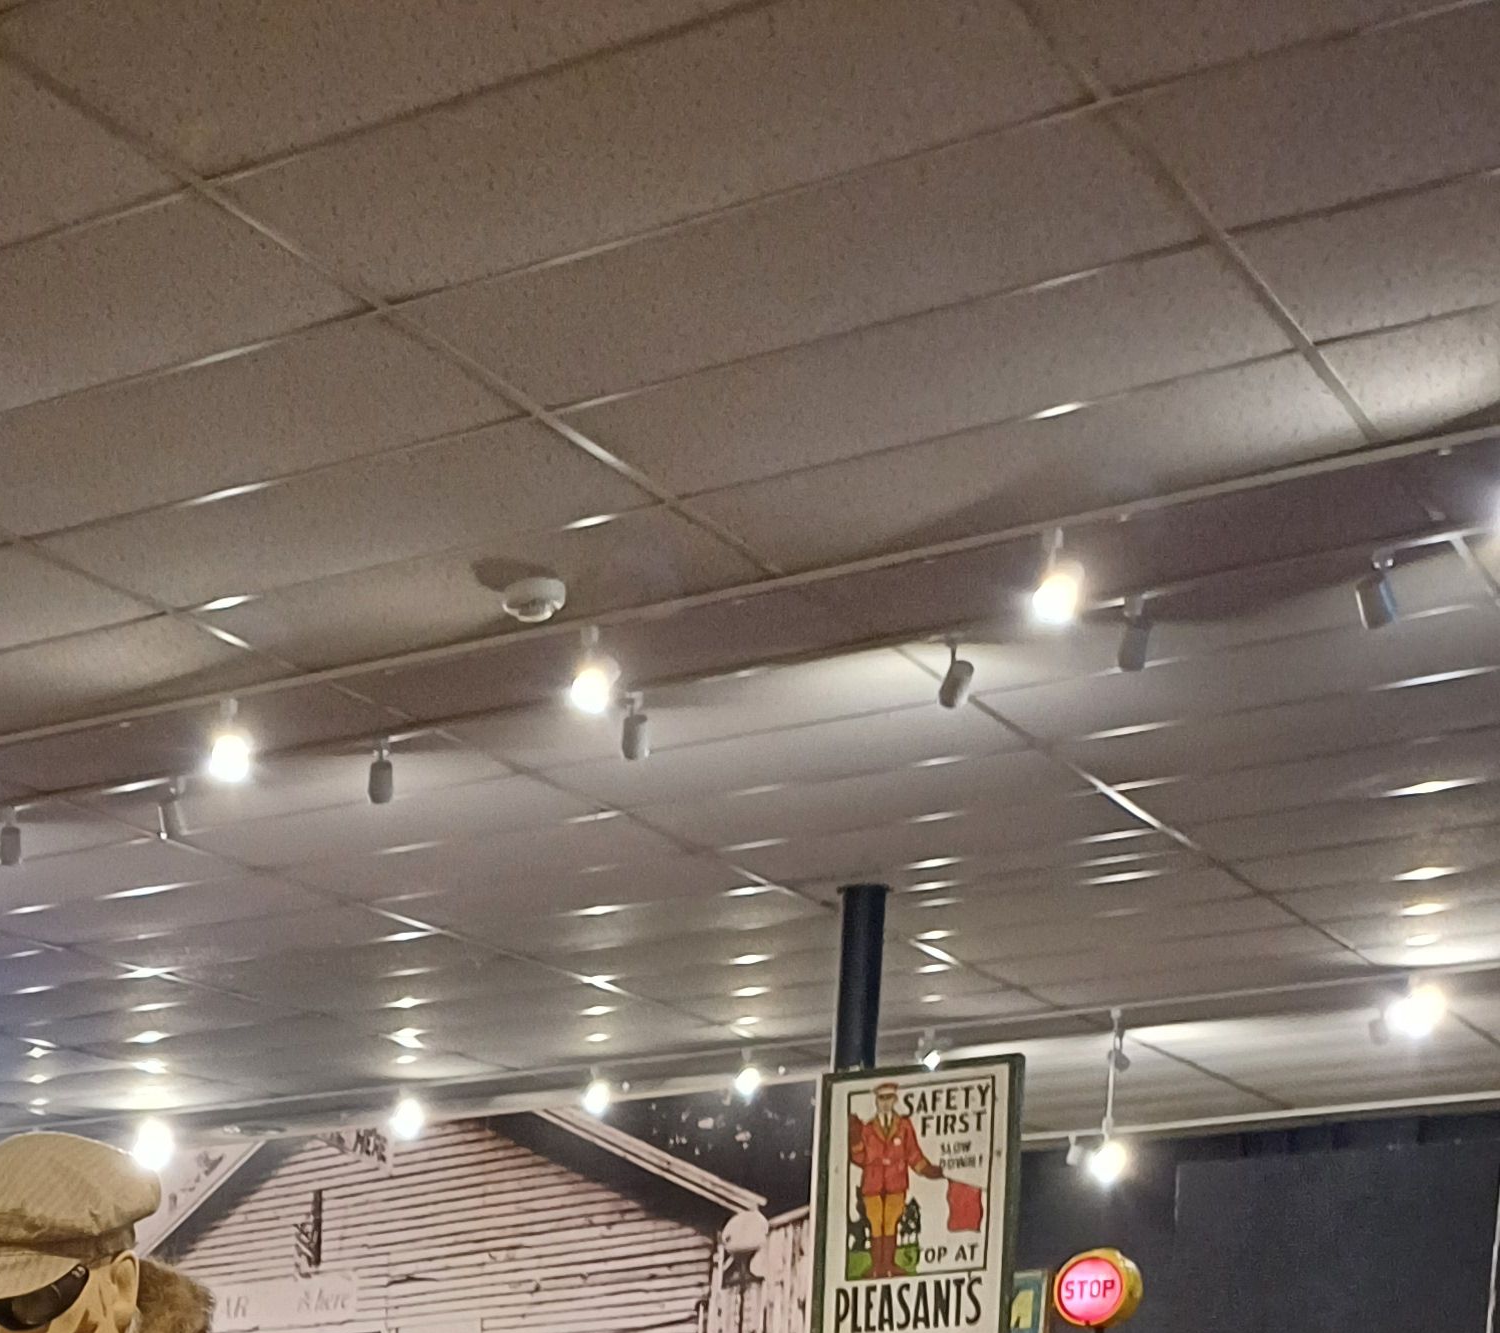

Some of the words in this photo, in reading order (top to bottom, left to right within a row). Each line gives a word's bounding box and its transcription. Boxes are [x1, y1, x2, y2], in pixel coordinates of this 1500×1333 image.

[903, 1083, 990, 1116] SAFETY
[921, 1110, 987, 1137] FIRST
[903, 1246, 947, 1264] STOP
[955, 1243, 978, 1261] AT
[1065, 1279, 1115, 1300] STOP
